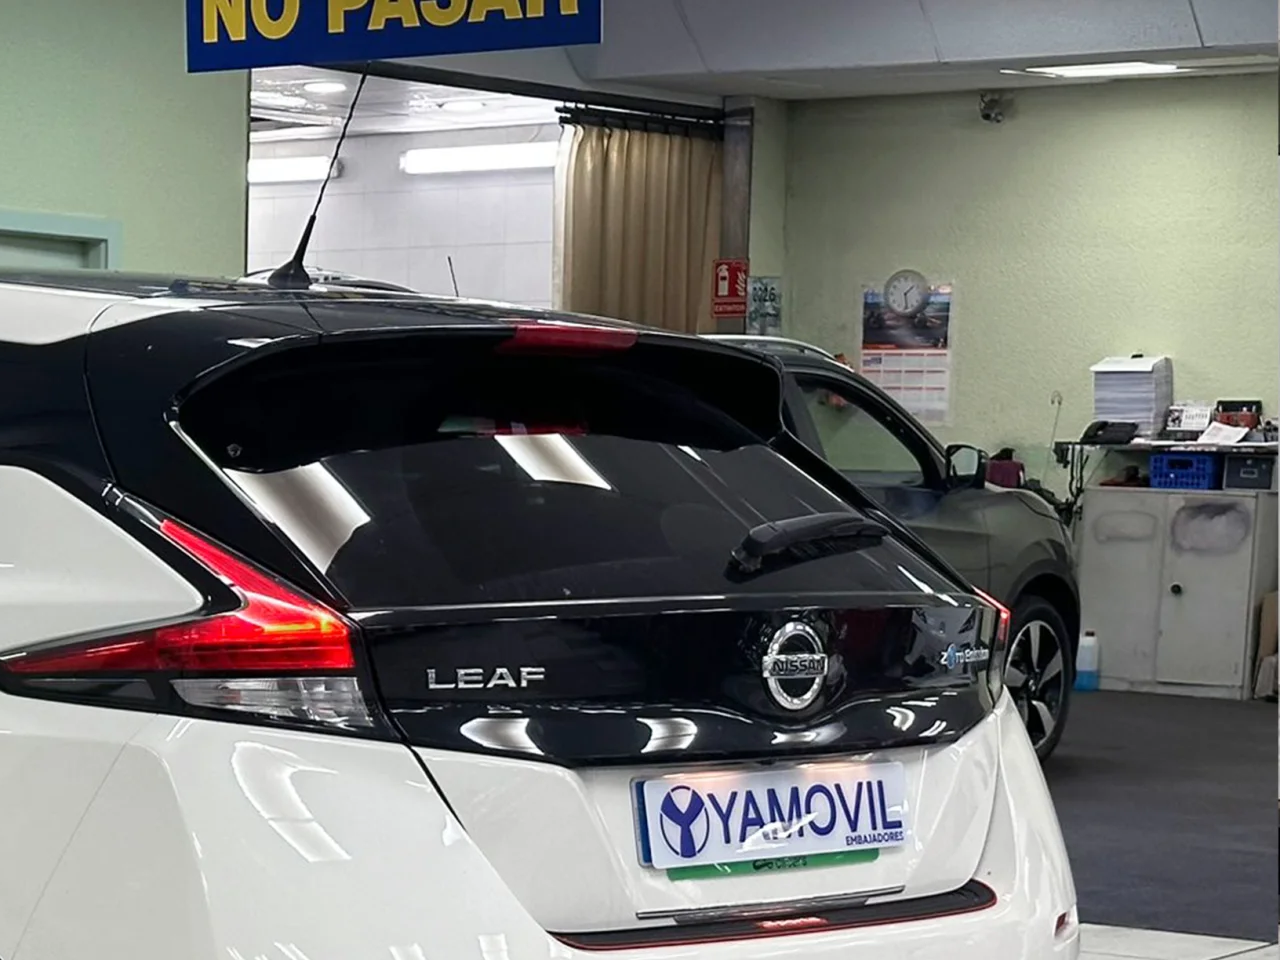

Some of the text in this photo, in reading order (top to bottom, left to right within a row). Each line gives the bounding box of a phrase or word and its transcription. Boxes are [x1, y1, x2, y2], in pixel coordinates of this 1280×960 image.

[772, 657, 825, 673] NISSAN
[426, 667, 545, 689] LEAF
[707, 780, 903, 844] YAMOVIL
[845, 831, 905, 846] EMBAJADORES
